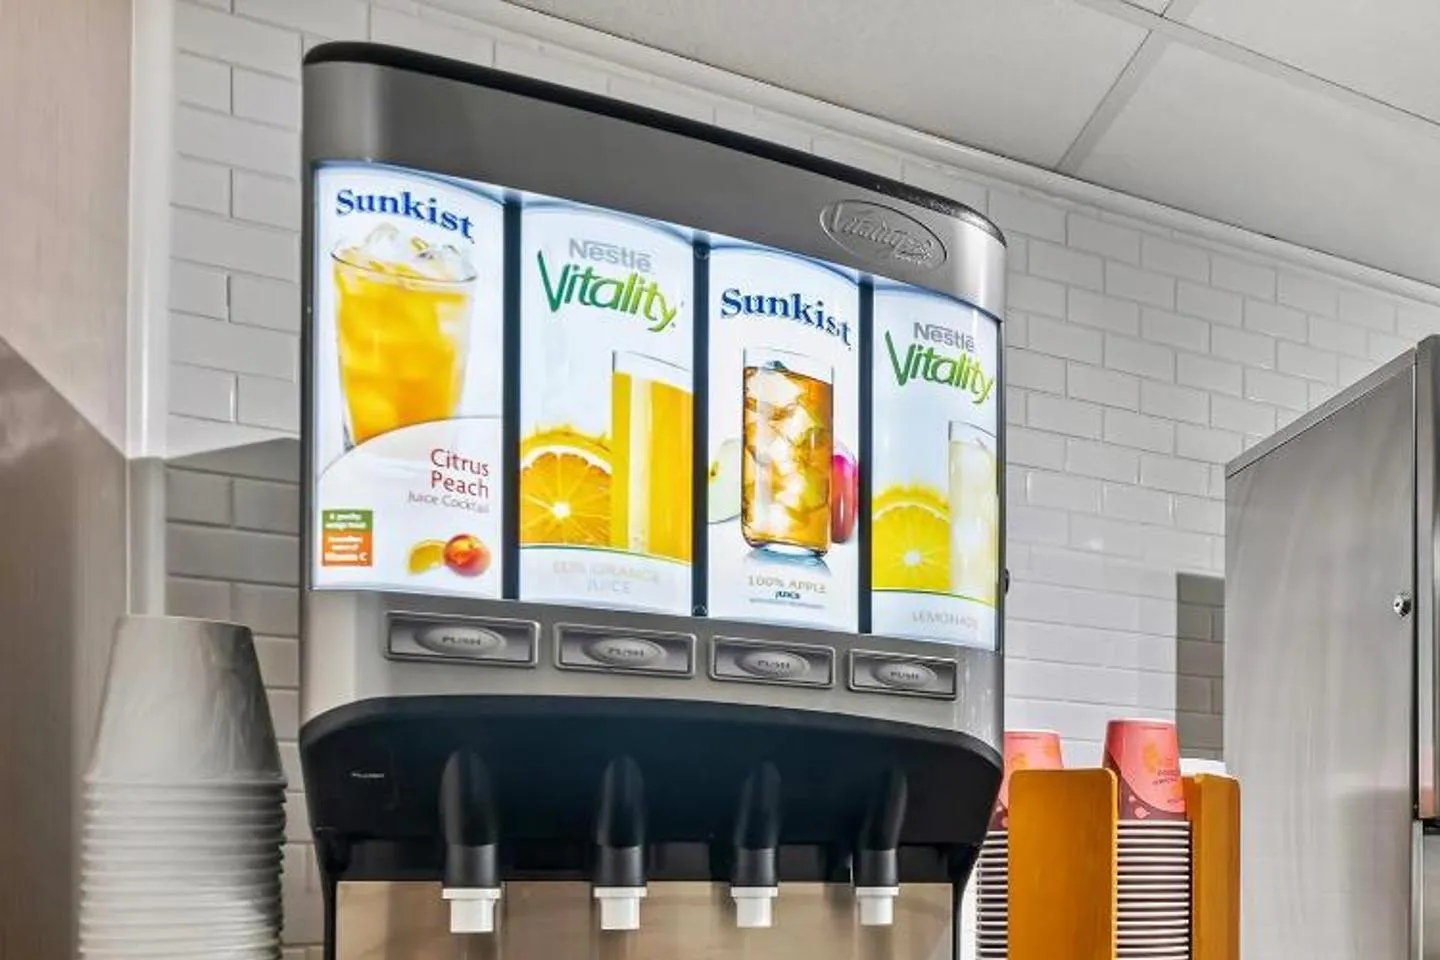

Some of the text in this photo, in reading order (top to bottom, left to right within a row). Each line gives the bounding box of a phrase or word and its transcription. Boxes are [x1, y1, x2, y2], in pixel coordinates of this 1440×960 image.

[335, 188, 475, 245] Sunkist
[537, 248, 677, 333] Vitality
[720, 288, 852, 350] Sunkist
[885, 329, 994, 405] Vitality
[430, 448, 489, 477] Citrus
[431, 469, 489, 499] Peach
[441, 635, 482, 646] PUSH
